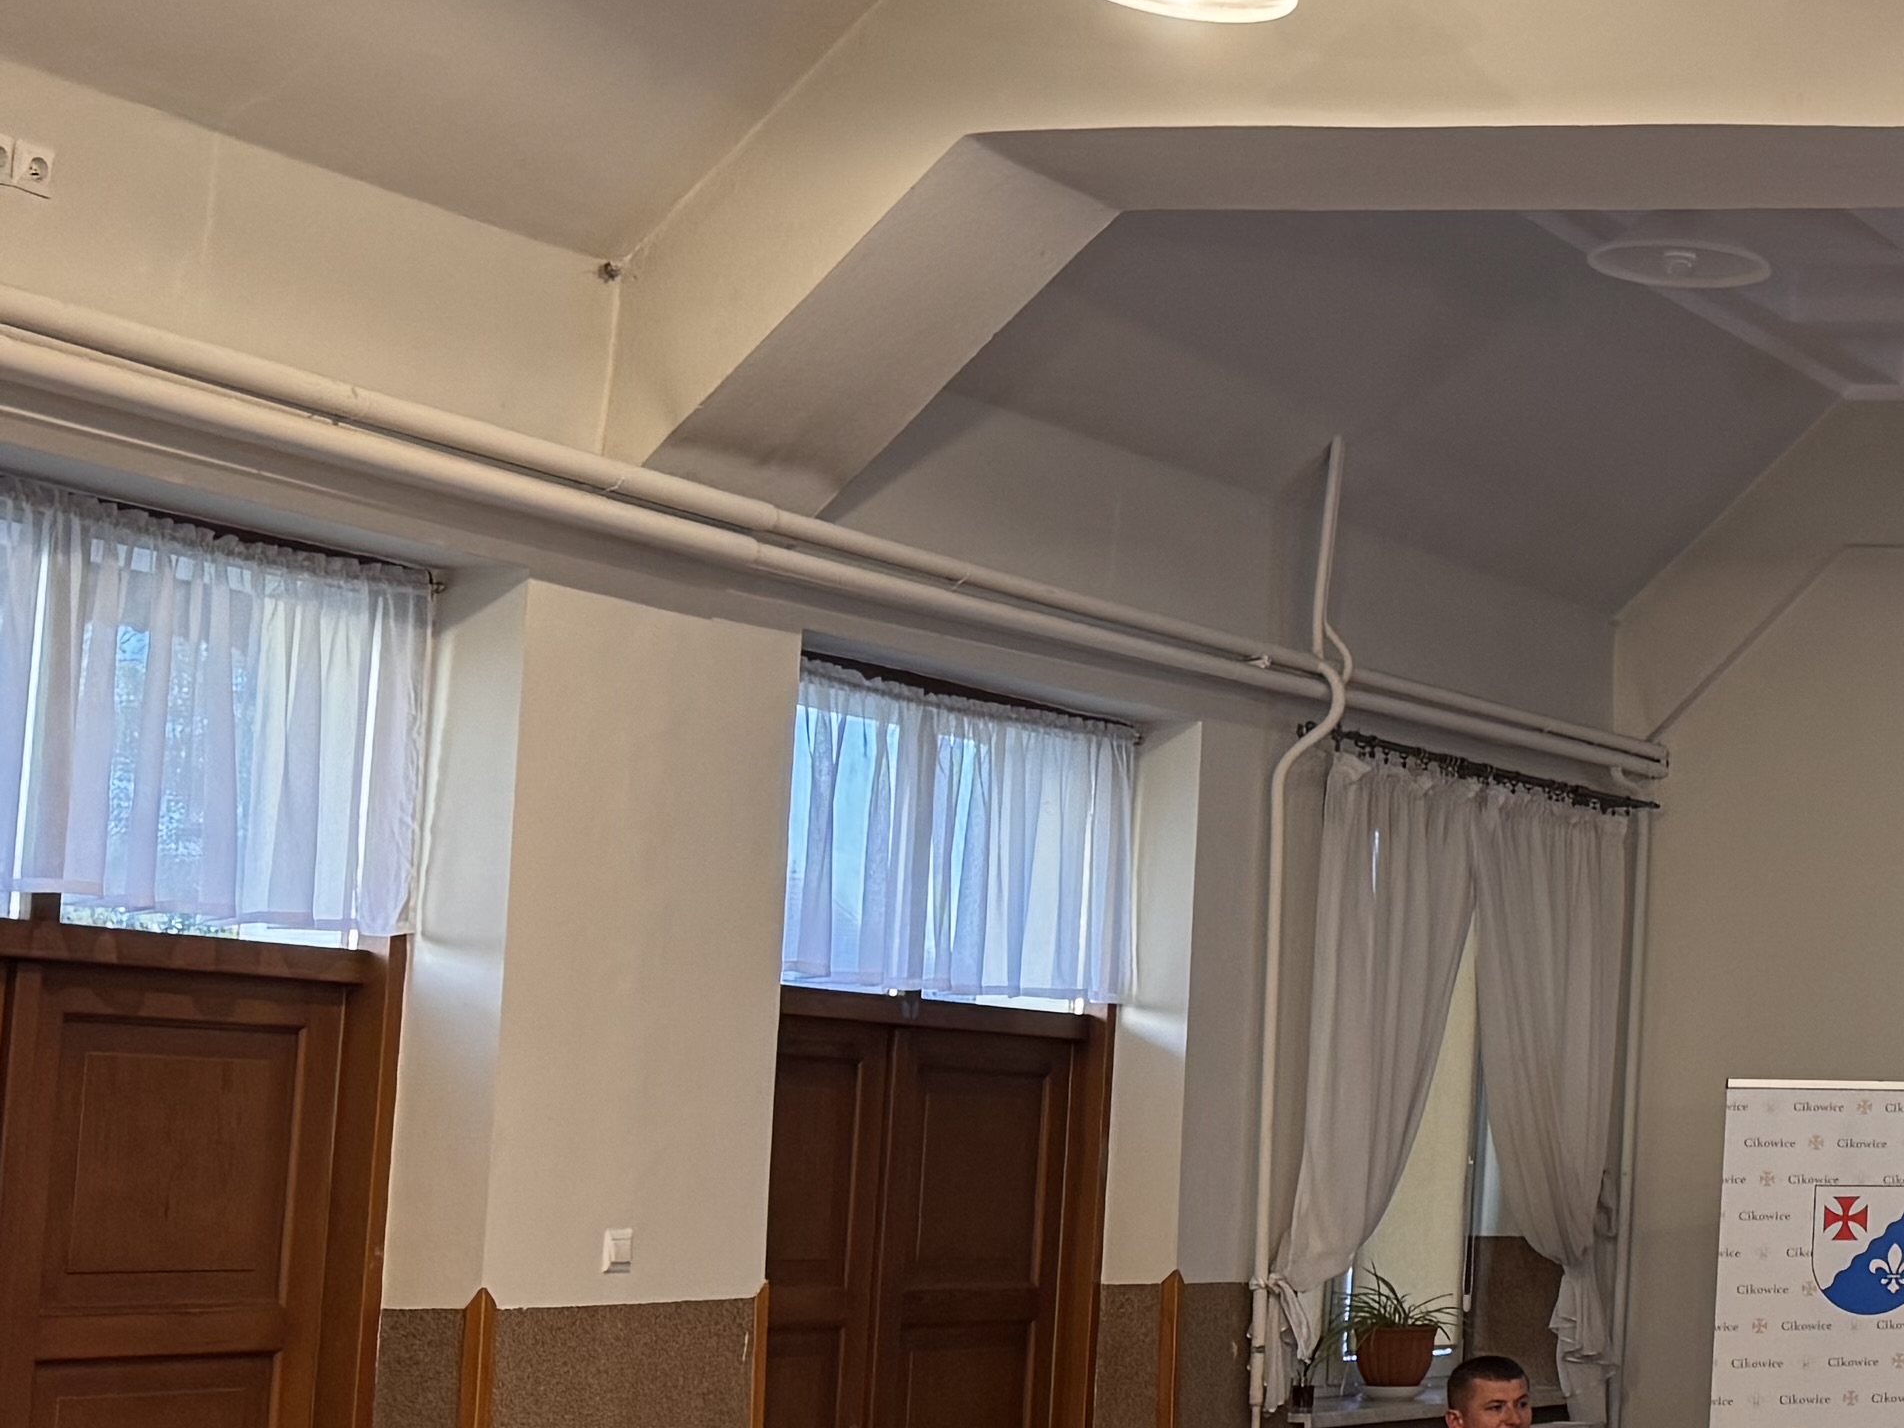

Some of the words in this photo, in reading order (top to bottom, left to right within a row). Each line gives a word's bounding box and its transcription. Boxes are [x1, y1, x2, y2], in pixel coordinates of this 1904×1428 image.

[1793, 1101, 1844, 1113] Cikowice
[1743, 1137, 1796, 1149] Cikowice
[1837, 1138, 1887, 1149] Cikowice
[1738, 1210, 1791, 1222] Cikowice
[1736, 1283, 1789, 1295] Cikowice
[1780, 1319, 1832, 1331] Cikowice
[1731, 1357, 1784, 1369] Cikowice
[1827, 1356, 1879, 1368] Cikowice
[1779, 1394, 1831, 1405] Cikowice
